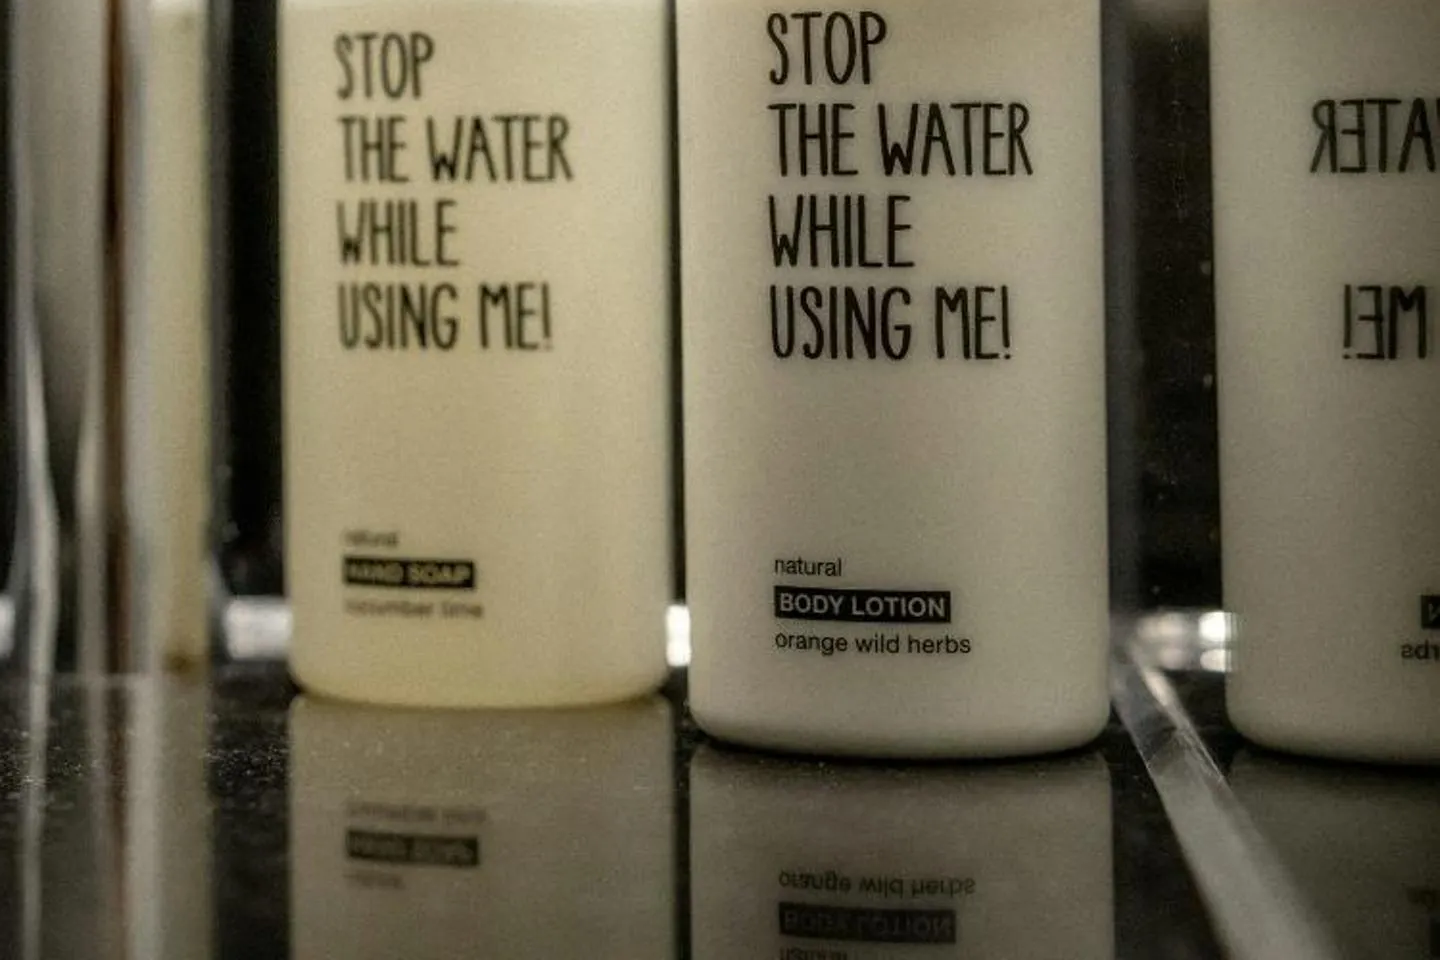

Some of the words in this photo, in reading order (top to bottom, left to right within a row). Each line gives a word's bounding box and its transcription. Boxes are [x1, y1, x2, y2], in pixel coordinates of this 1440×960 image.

[334, 31, 435, 100] STOP
[766, 11, 887, 85] STOP
[337, 115, 409, 183] THE
[425, 114, 575, 183] WATER
[766, 102, 859, 176] THE
[877, 102, 1034, 176] WATER
[336, 198, 460, 267] WHILE
[768, 194, 915, 268] WHILE
[337, 282, 460, 351] USING
[478, 282, 553, 351] ME!
[769, 284, 912, 361] USING
[934, 284, 1012, 360] ME!
[773, 557, 842, 577] natural
[779, 592, 844, 616] BODY
[852, 596, 946, 618] LOTION
[774, 632, 848, 657] orange
[854, 635, 900, 654] wild
[908, 636, 971, 655] herbs
